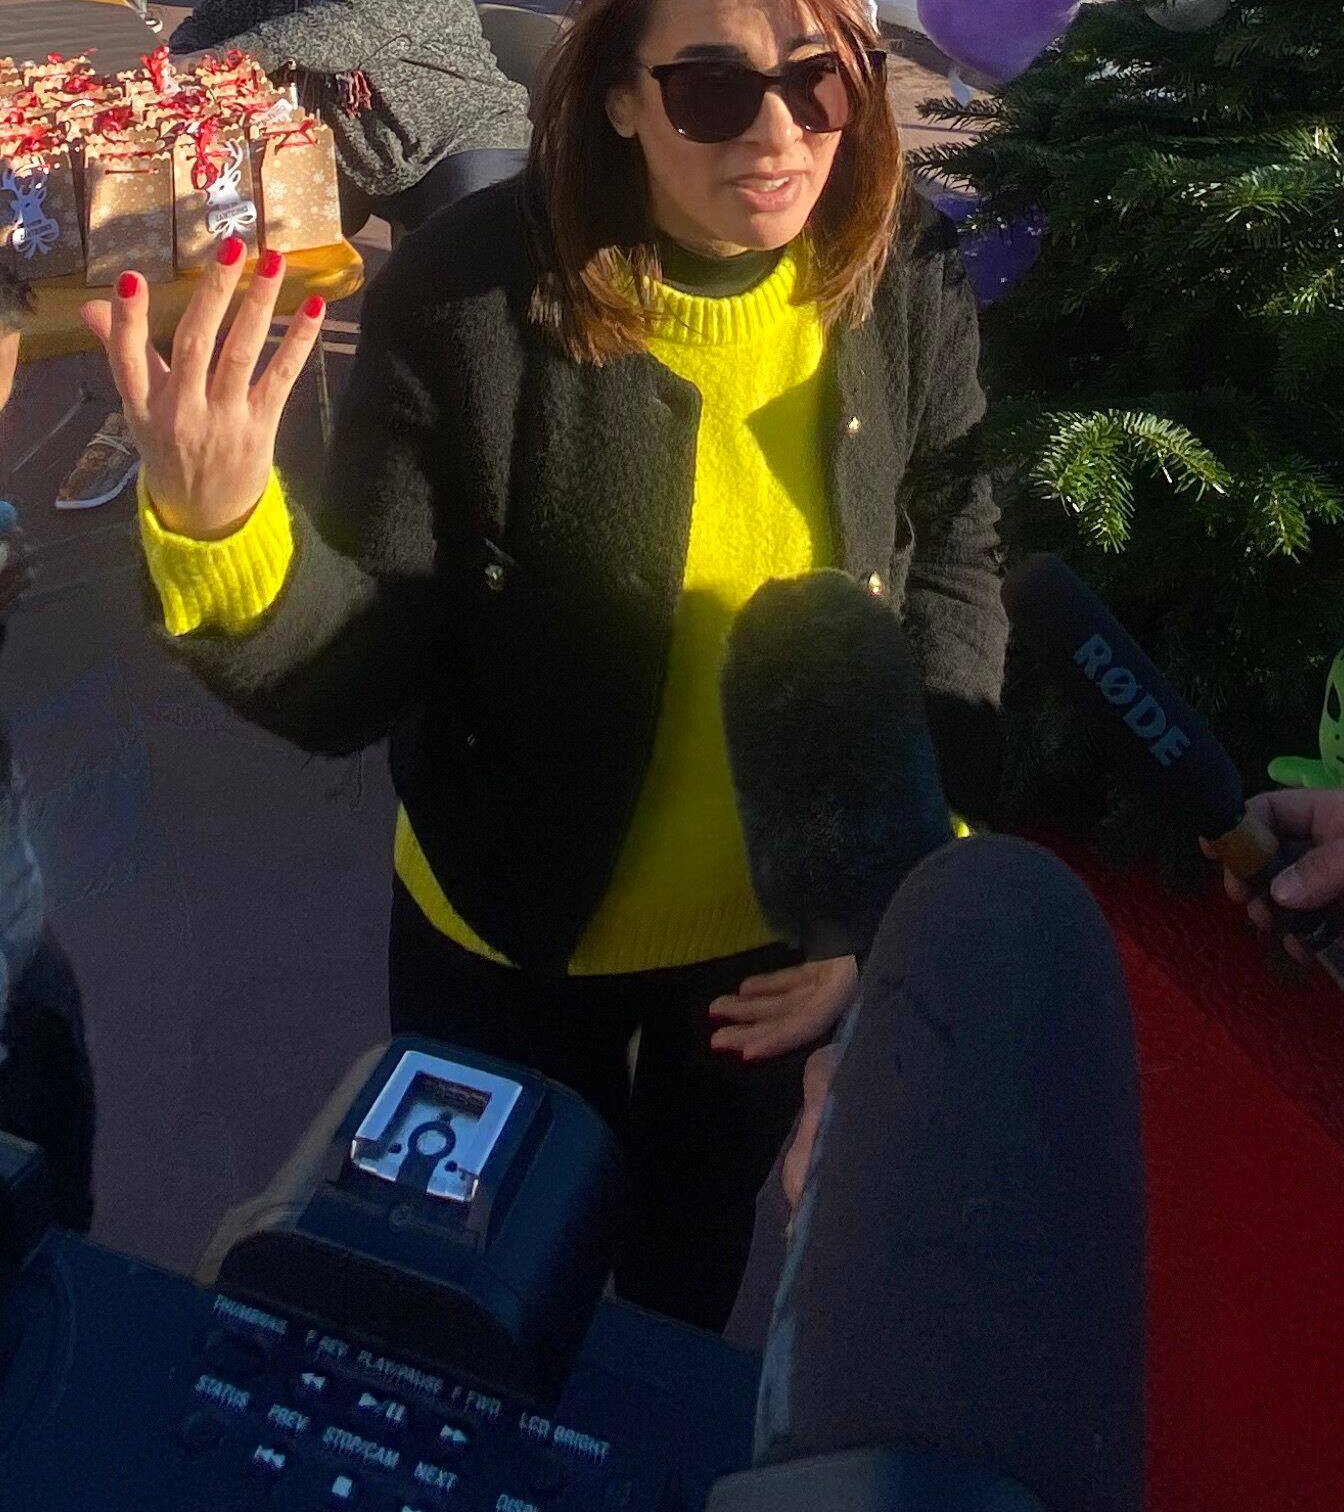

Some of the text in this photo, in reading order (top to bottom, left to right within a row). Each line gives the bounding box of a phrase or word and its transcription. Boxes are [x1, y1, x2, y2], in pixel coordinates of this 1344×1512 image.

[194, 1374, 252, 1409] STATUS
[267, 1403, 312, 1432] PREV
[518, 1411, 611, 1457] LCD BRIGHT
[413, 1460, 458, 1490] NEXT
